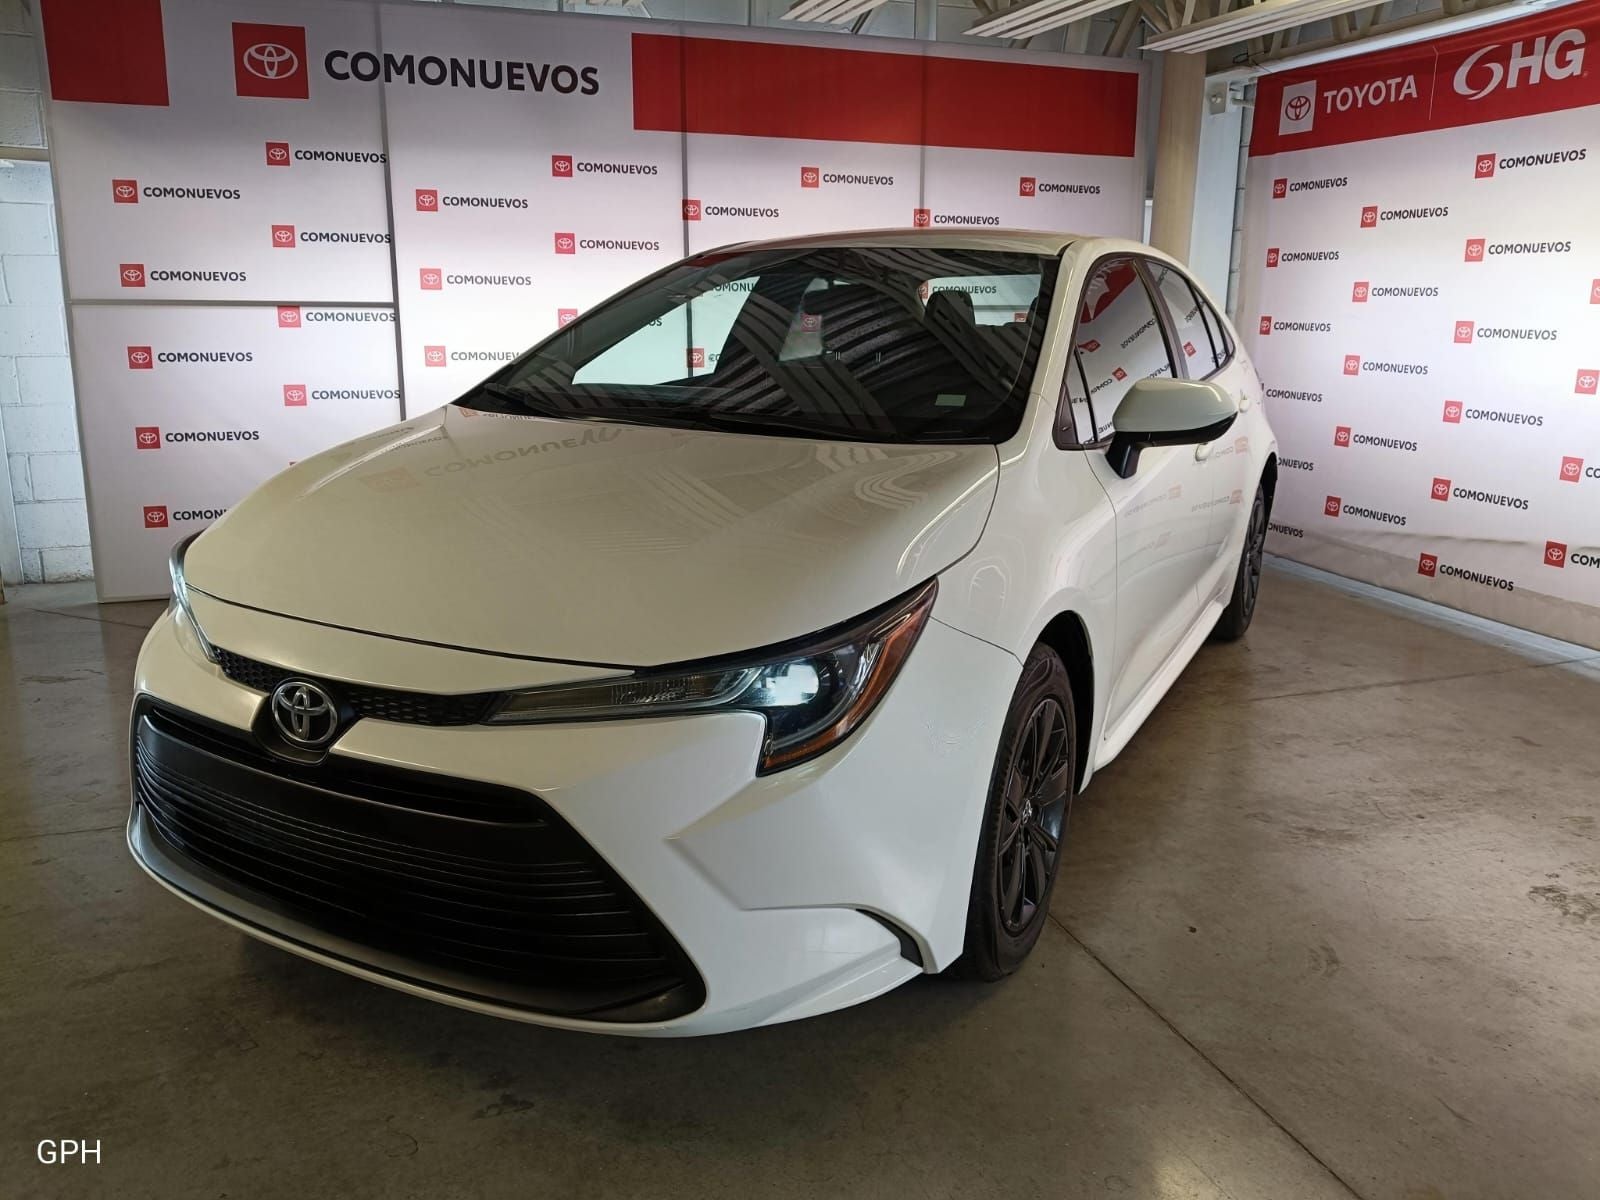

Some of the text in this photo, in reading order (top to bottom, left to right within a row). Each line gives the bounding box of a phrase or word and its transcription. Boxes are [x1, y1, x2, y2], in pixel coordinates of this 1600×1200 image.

[325, 50, 599, 96] COMONUEVOS
[1323, 74, 1418, 114] TOYOTA
[294, 149, 387, 164] COMONUEVOS
[1498, 148, 1587, 170] COMONUEVOS
[576, 161, 658, 175] COMONUEVOS
[823, 173, 894, 186] COMONUEVOS
[1289, 176, 1348, 193] COMONUEVOS
[143, 186, 241, 200] COMONUEVOS
[1038, 182, 1101, 195] COMONUEVOS
[441, 196, 529, 209] COMONUEVOS
[704, 205, 780, 218] COMONUEVOS
[1379, 206, 1449, 221] COMONUEVOS
[933, 214, 1000, 226] COMONUEVOS
[299, 231, 391, 244] COMONUEVOS
[579, 239, 660, 251] COMONUEVOS
[1487, 241, 1571, 255] COMONUEVOS
[1281, 250, 1340, 263] COMONUEVOS
[150, 270, 247, 283] COMONUEVOS
[446, 274, 532, 286] COMONUEVOS
[1371, 286, 1439, 298] COMONUEVOS
[305, 311, 396, 323] COMONUEVOS
[1273, 321, 1332, 333] COMONUEVOS
[1476, 327, 1558, 342] COMONUEVOS
[157, 351, 253, 364] COMONUEVOS
[1362, 361, 1429, 376] COMONUEVOS
[311, 389, 401, 400] COMONUEVOS
[1266, 388, 1323, 403] COMONUEVOS
[1465, 408, 1544, 427] COMONUEVOS
[165, 430, 260, 443] COMONUEVOS
[1352, 434, 1418, 452] COMONUEVOS
[1452, 487, 1529, 510] COMONUEVOS
[1342, 504, 1407, 526] COMONUEVOS
[1438, 564, 1515, 592] COMONUEVOS
